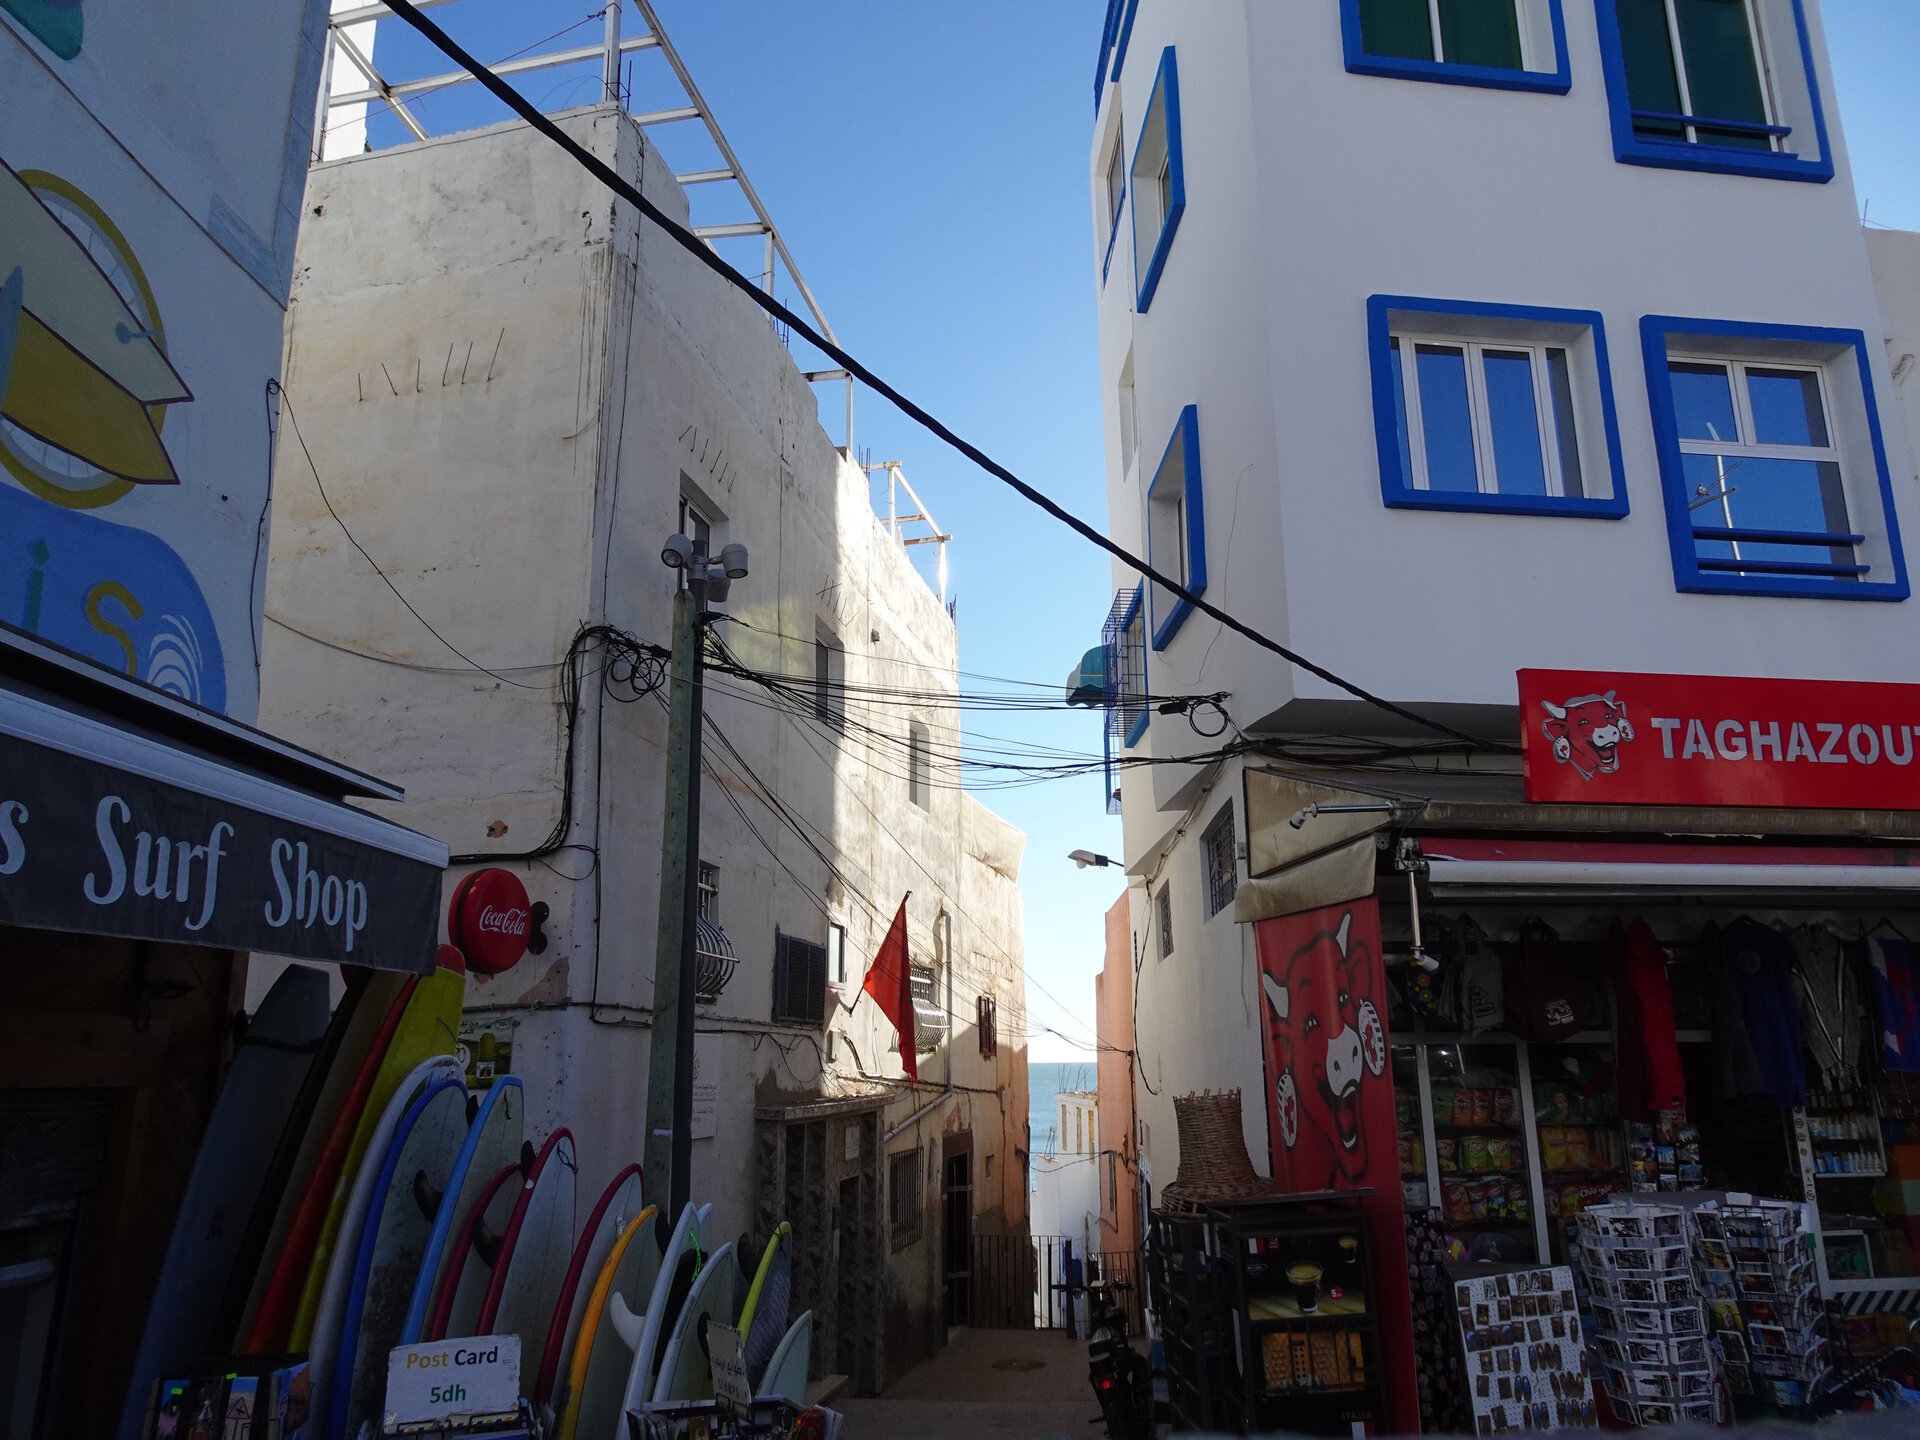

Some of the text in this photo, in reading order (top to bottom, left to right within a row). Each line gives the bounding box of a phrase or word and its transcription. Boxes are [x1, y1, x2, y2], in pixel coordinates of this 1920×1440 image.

[1651, 717, 1920, 766] TAGHAZOU
[83, 795, 235, 931] Surf
[264, 838, 368, 951] Shop
[406, 1345, 498, 1369] Post Card
[430, 1384, 467, 1404] 5dh
